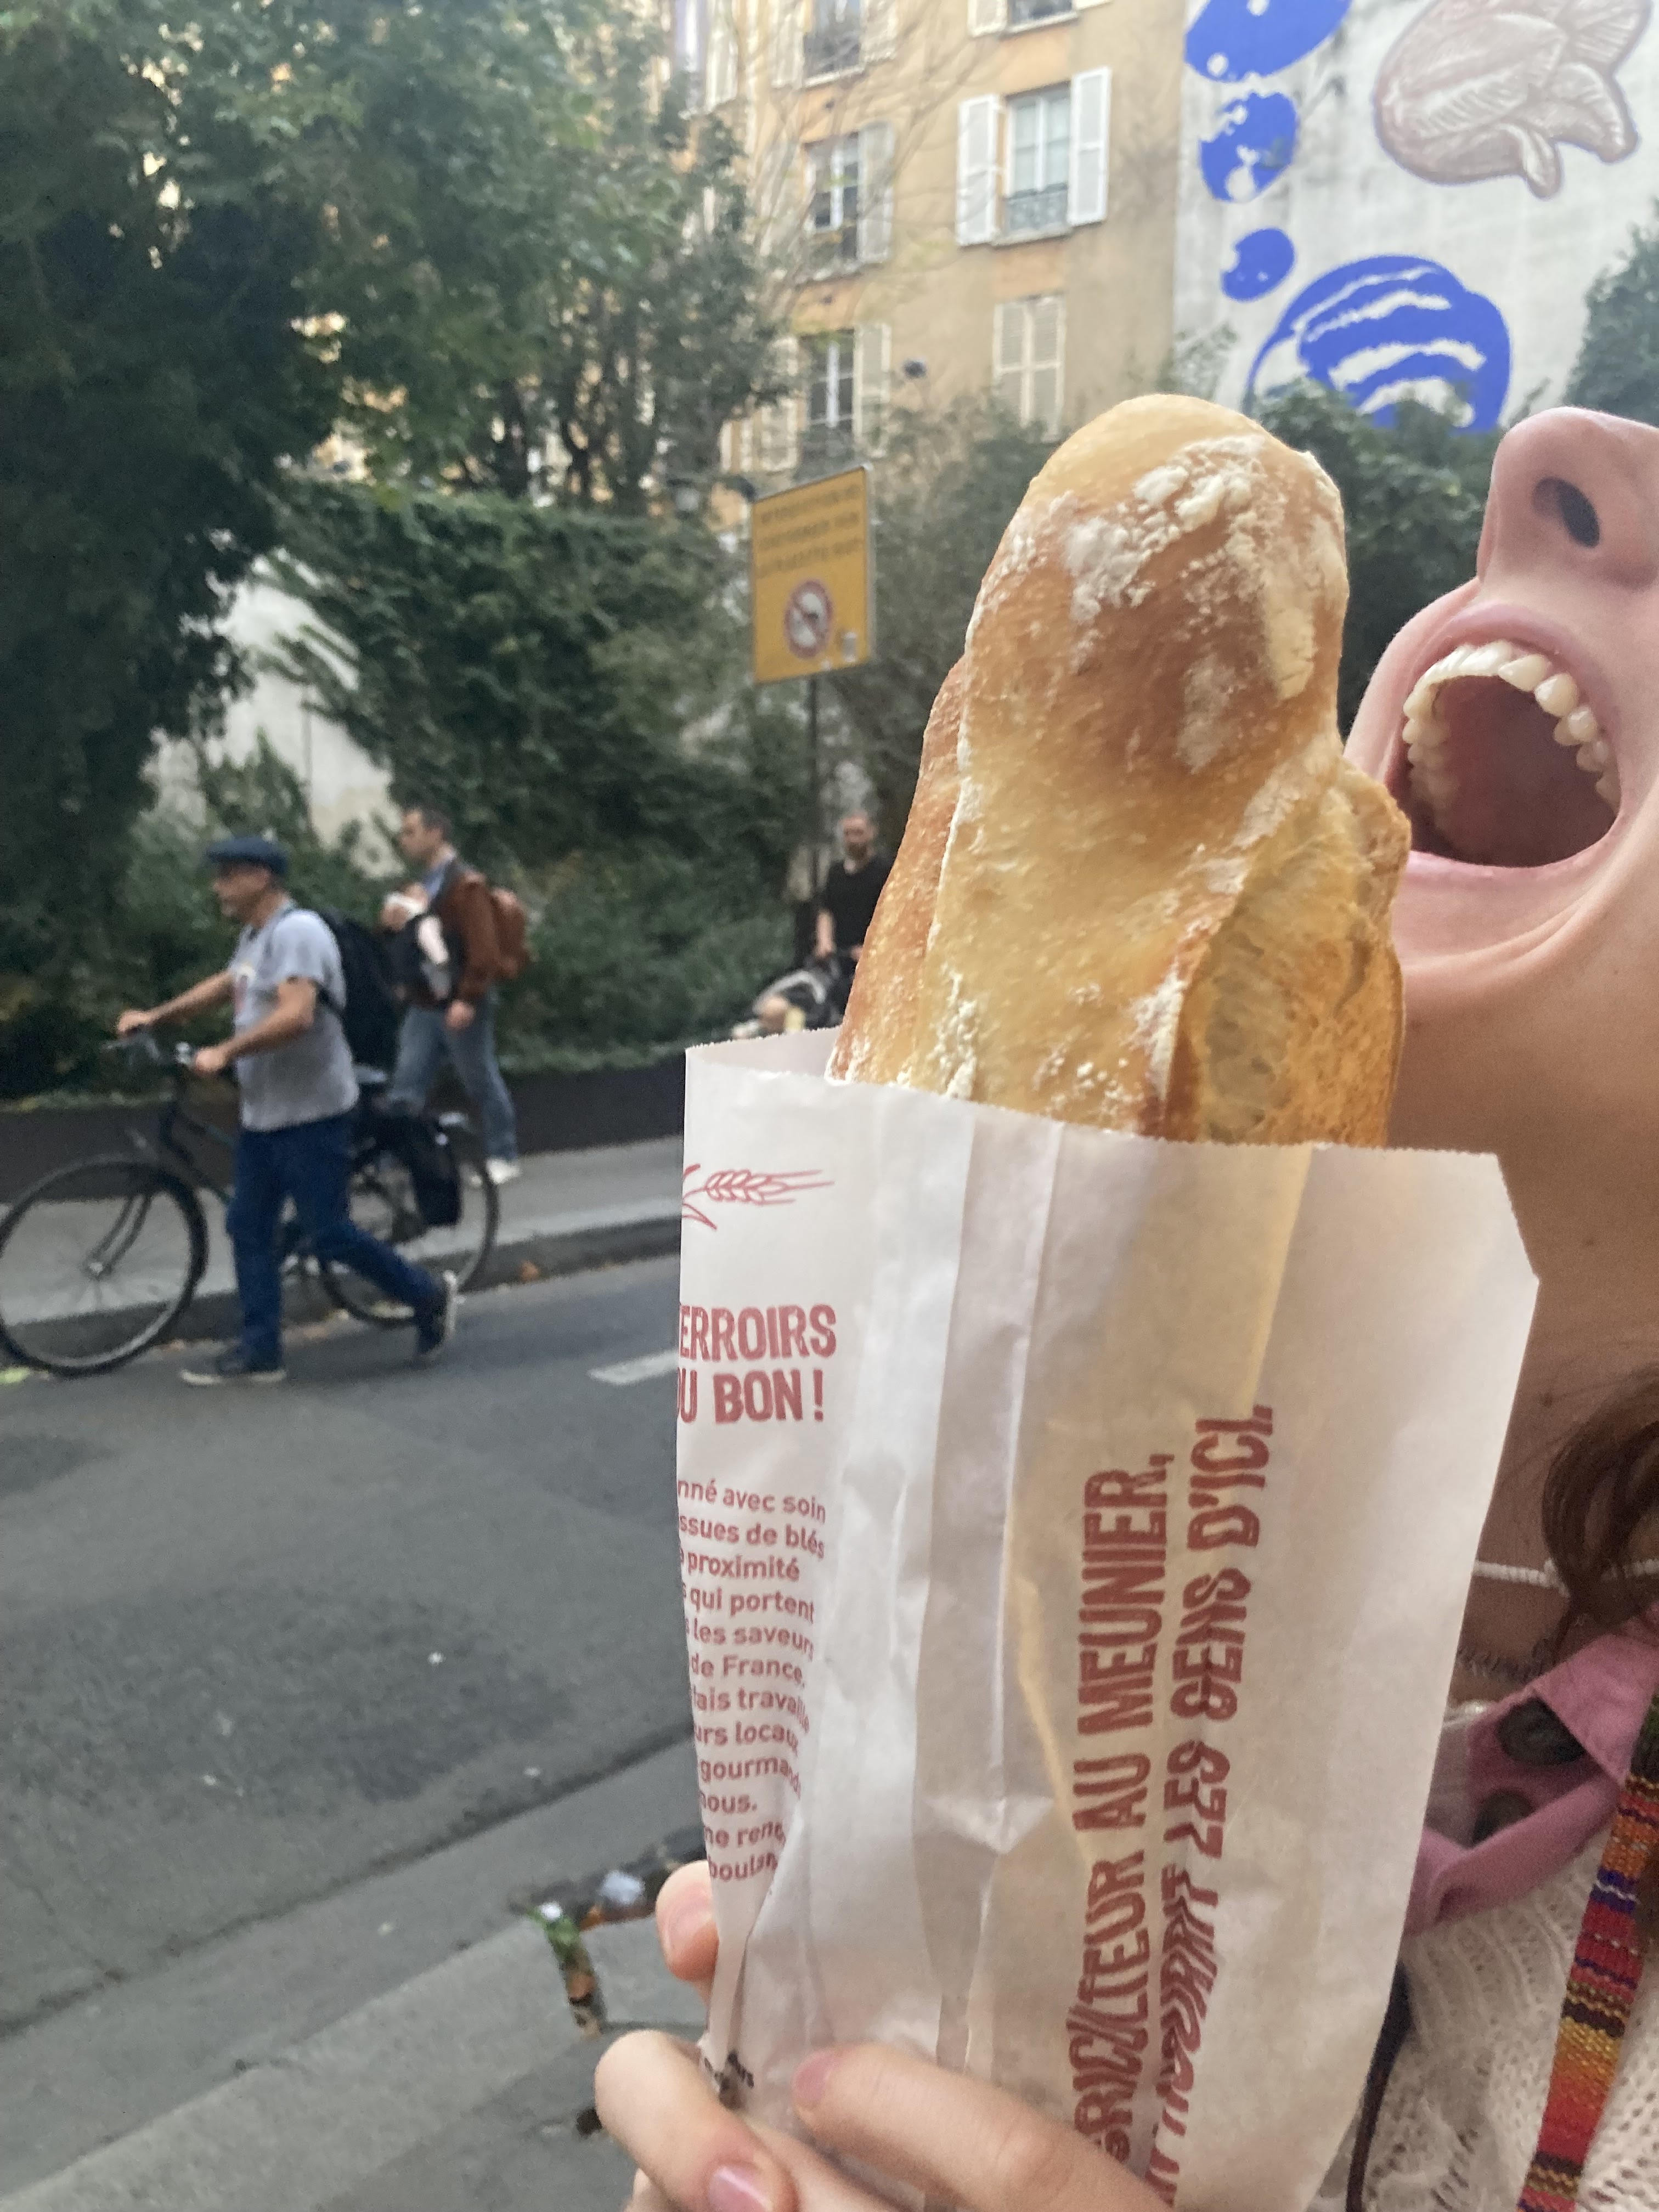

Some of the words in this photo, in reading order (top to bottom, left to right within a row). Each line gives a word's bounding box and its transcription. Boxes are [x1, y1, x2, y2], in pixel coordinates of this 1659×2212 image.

[678, 1367, 697, 1424] U
[723, 1488, 775, 1512] avec
[783, 1495, 826, 1524] soin
[746, 1522, 777, 1545] de
[786, 1523, 825, 1559] blés
[687, 1551, 800, 1582] proximité
[690, 1587, 723, 1612] qui
[1077, 1453, 1175, 1736] MEUNIER,
[693, 1617, 726, 1645] les
[1170, 1567, 1251, 1721] GENS
[692, 1653, 714, 1678] de
[1073, 1753, 1152, 1831] AU
[1164, 1739, 1231, 1859] LES
